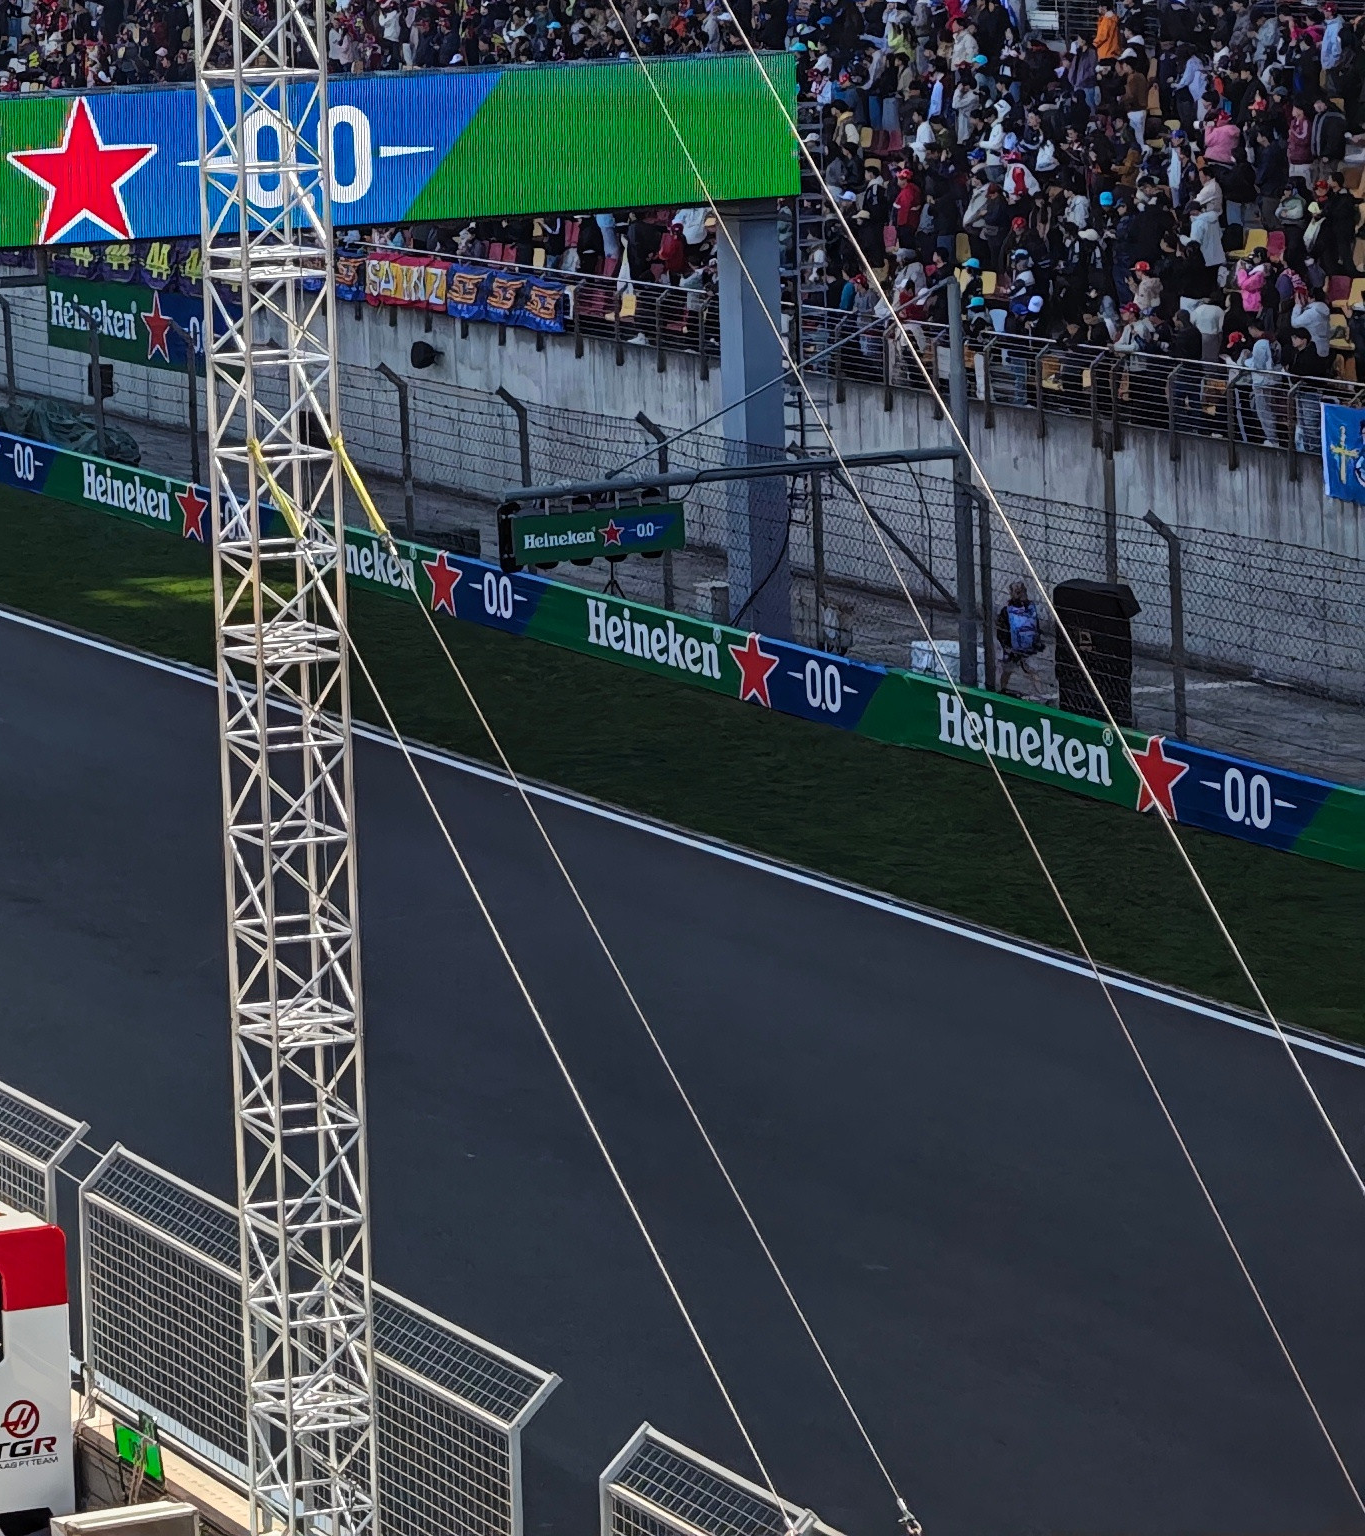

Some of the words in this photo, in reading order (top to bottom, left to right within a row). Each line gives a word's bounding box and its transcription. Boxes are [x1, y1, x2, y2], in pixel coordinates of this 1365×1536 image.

[368, 260, 446, 305] SAINZ
[315, 538, 416, 591] neken
[805, 659, 842, 713] 0.0
[1223, 767, 1272, 830] 0.0
